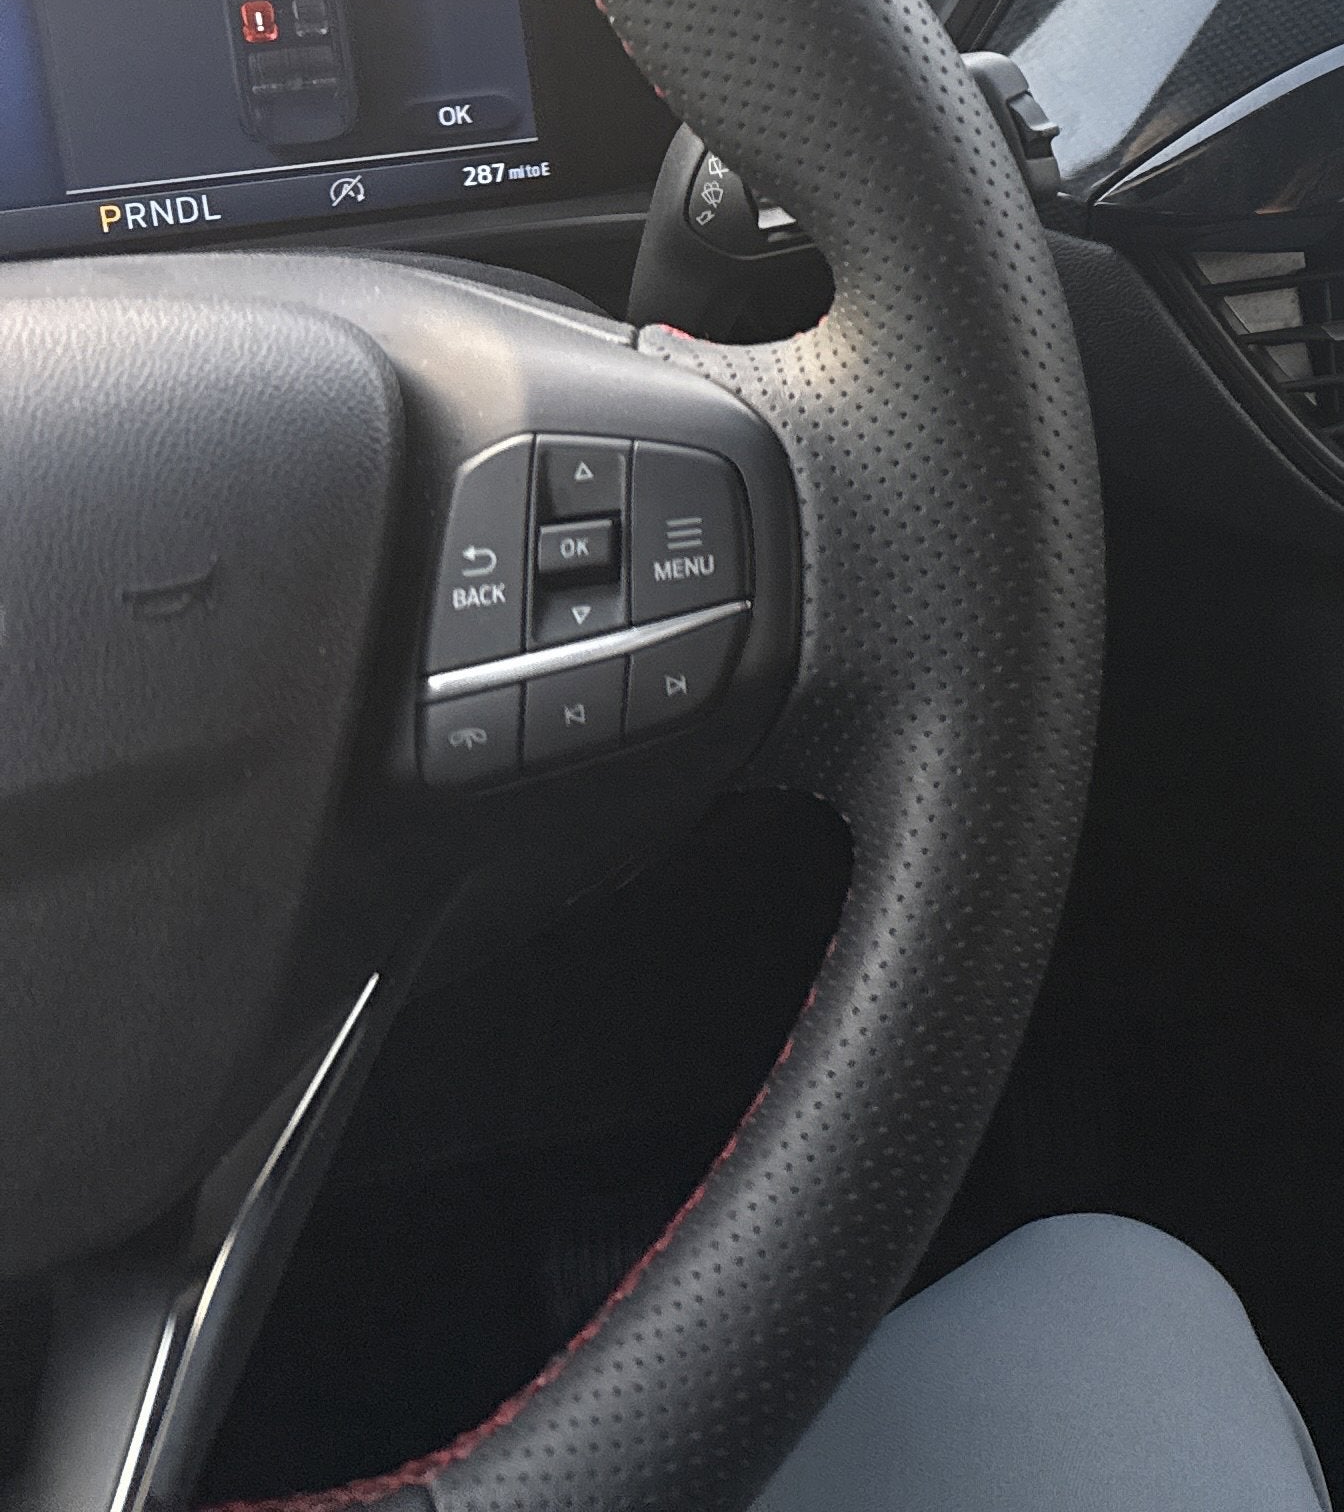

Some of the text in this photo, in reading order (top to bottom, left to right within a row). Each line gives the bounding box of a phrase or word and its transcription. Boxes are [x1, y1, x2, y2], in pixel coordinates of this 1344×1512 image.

[438, 104, 473, 127] OK
[461, 162, 505, 187] 287
[100, 194, 222, 233] PRNDL
[559, 538, 590, 558] OK
[653, 554, 715, 582] MENU
[452, 583, 505, 610] BACK
